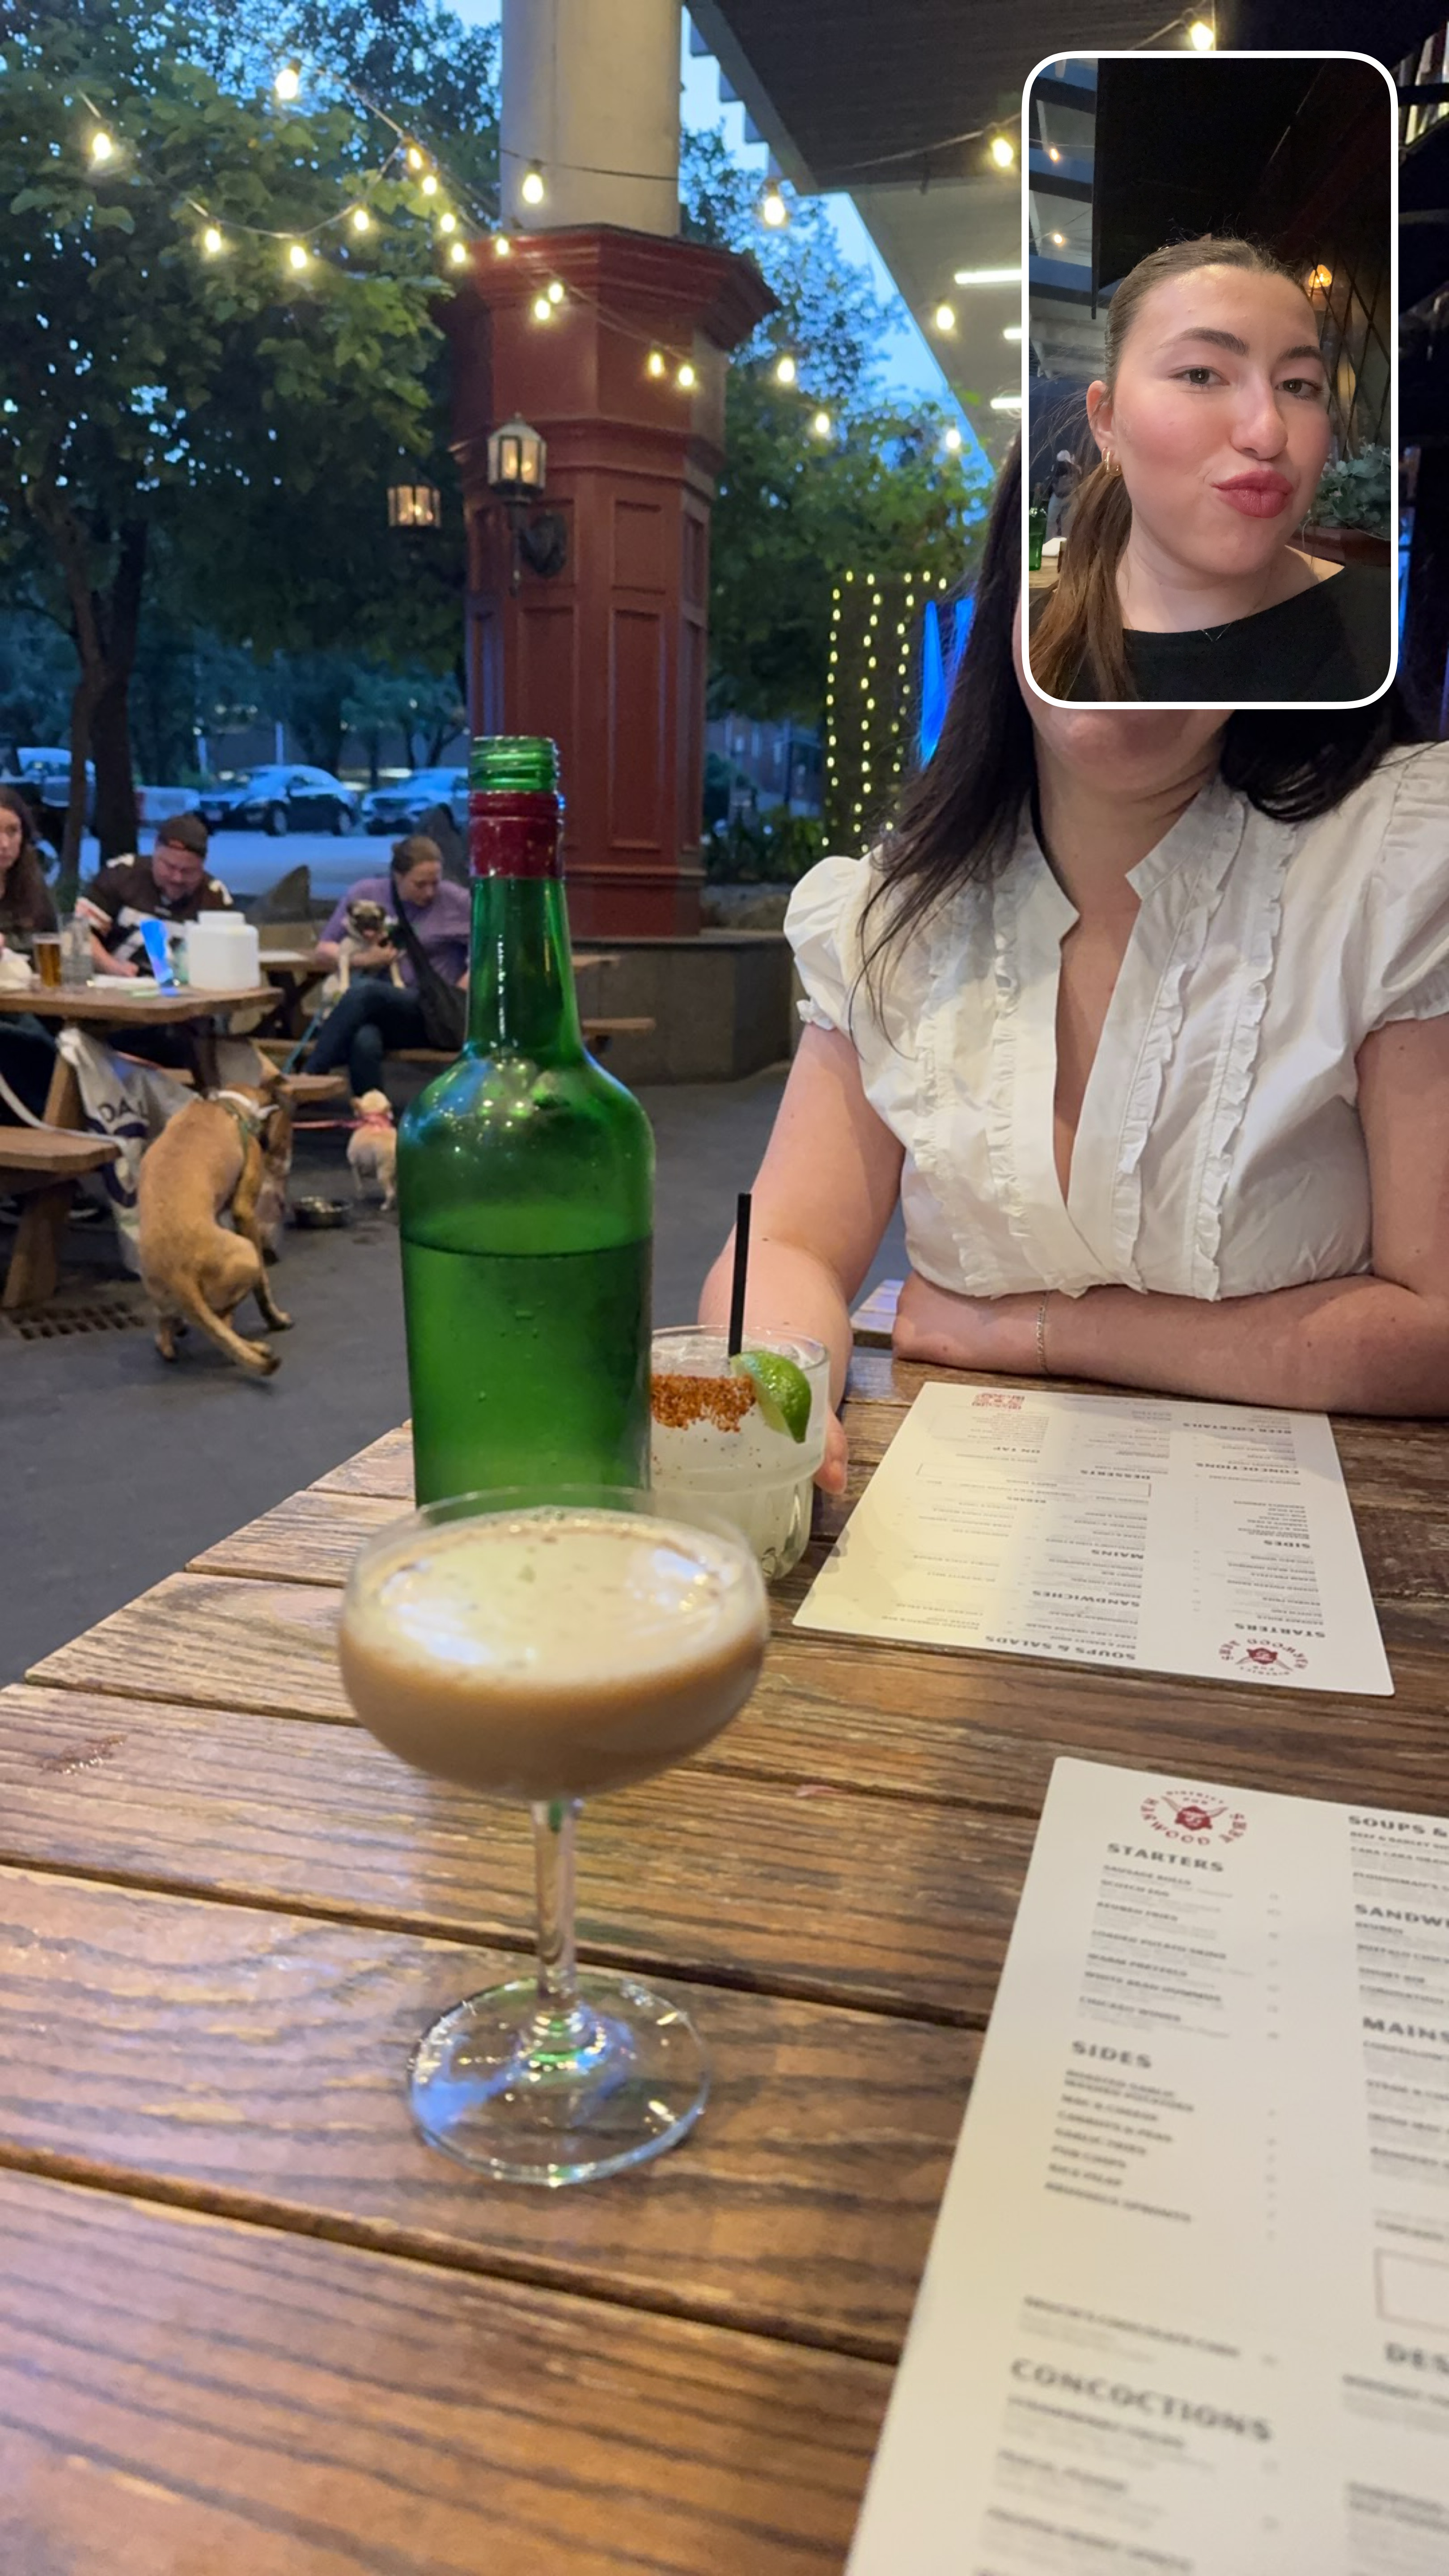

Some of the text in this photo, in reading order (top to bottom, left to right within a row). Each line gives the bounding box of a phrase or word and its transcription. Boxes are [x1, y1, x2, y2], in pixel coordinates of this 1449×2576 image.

[1195, 1463, 1299, 1474] CONCOCTIONS
[1263, 1540, 1311, 1549] SIDES
[1091, 1549, 1144, 1560] MAINS
[1033, 1590, 1140, 1608] SANDWICHES
[1234, 1623, 1326, 1638] STARTERS
[986, 1635, 1052, 1650] SALADS
[1076, 1647, 1135, 1660] SOUPS
[1348, 1816, 1425, 1834] SOUPS
[1107, 1843, 1224, 1872] STARTERS
[1072, 2040, 1152, 2069] SIDES
[1009, 2356, 1272, 2445] CONCOCTIONS
